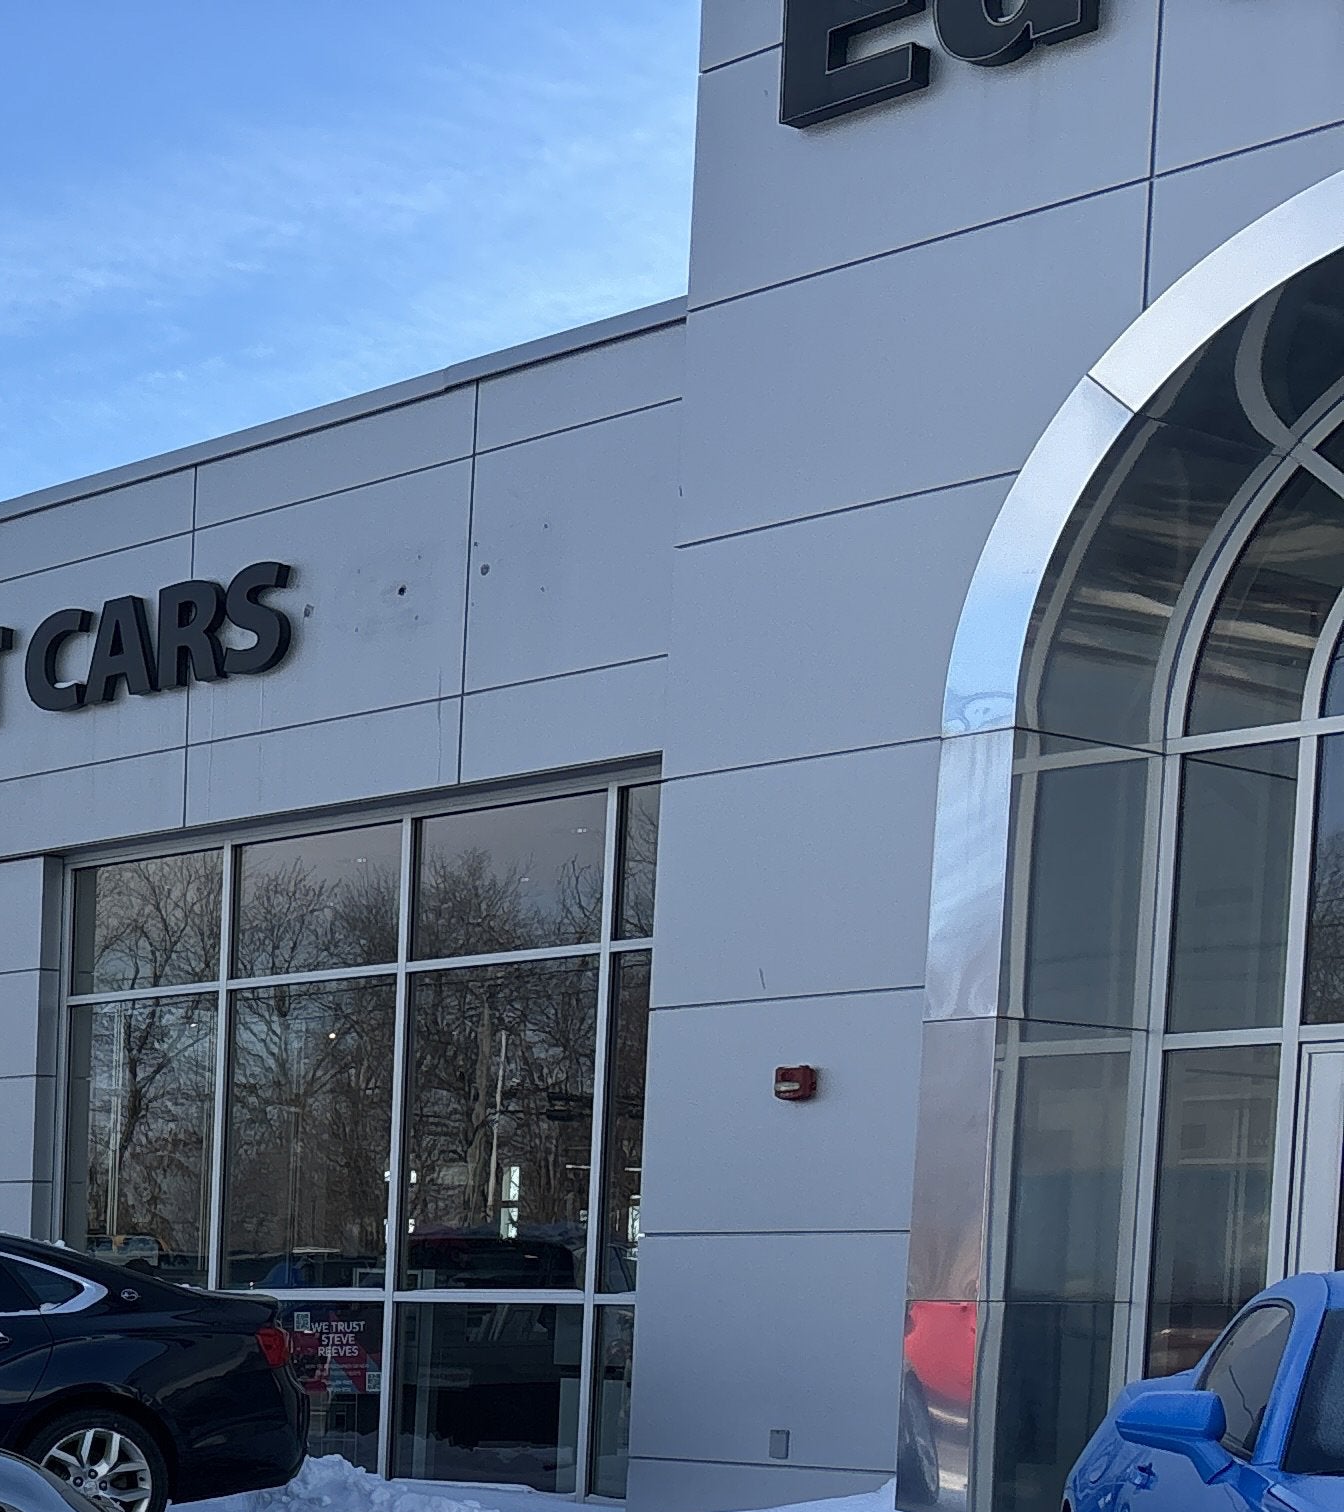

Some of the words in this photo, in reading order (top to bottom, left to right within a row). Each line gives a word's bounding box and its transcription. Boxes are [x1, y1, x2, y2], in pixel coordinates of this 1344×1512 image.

[25, 561, 292, 712] CARS
[311, 1322, 329, 1332] WE
[331, 1321, 365, 1332] TRUST
[321, 1334, 355, 1345] STEVE
[317, 1346, 359, 1357] REEVES
